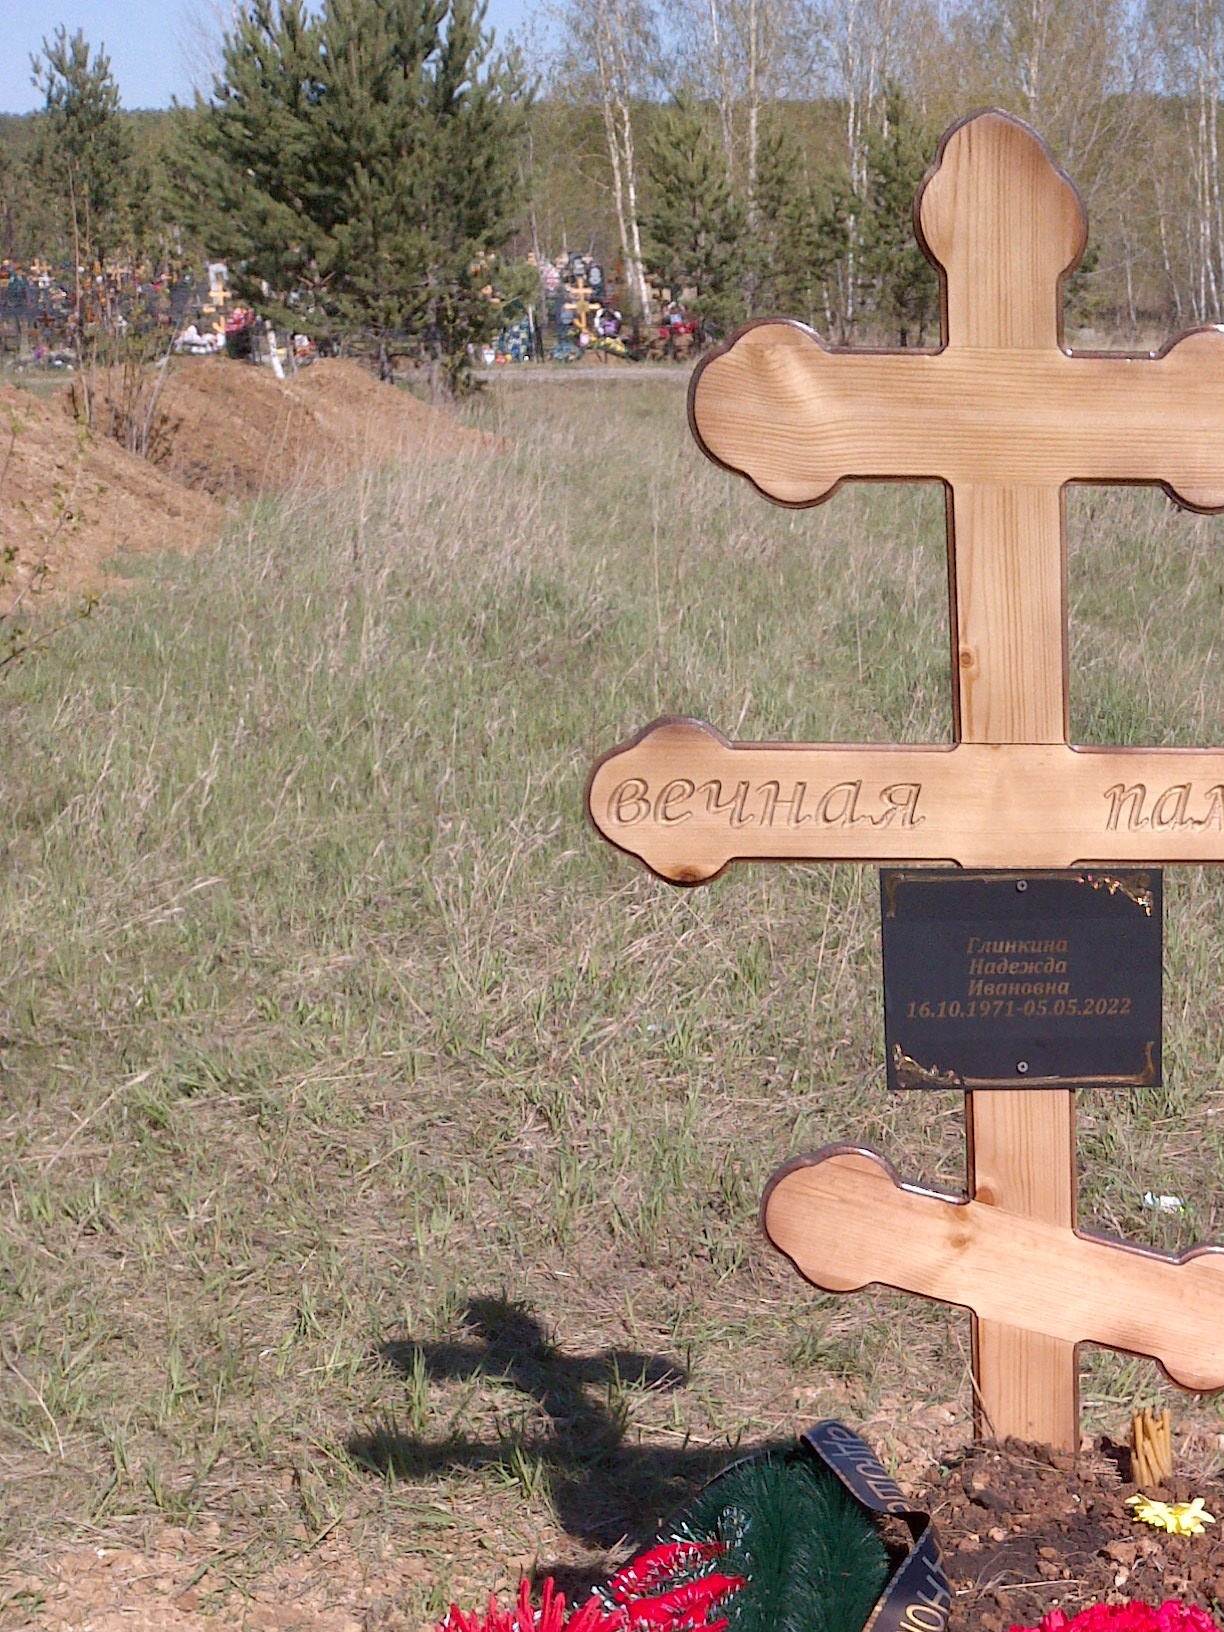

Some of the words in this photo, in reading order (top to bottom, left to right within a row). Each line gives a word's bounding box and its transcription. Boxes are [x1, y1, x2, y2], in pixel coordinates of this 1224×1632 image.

[606, 777, 926, 829] вечная
[966, 936, 1069, 954] Глинкина
[968, 957, 1069, 976] Надежда
[967, 979, 1070, 997] Ивановна
[906, 997, 1133, 1019] 16.10.1971-05.05.2022
